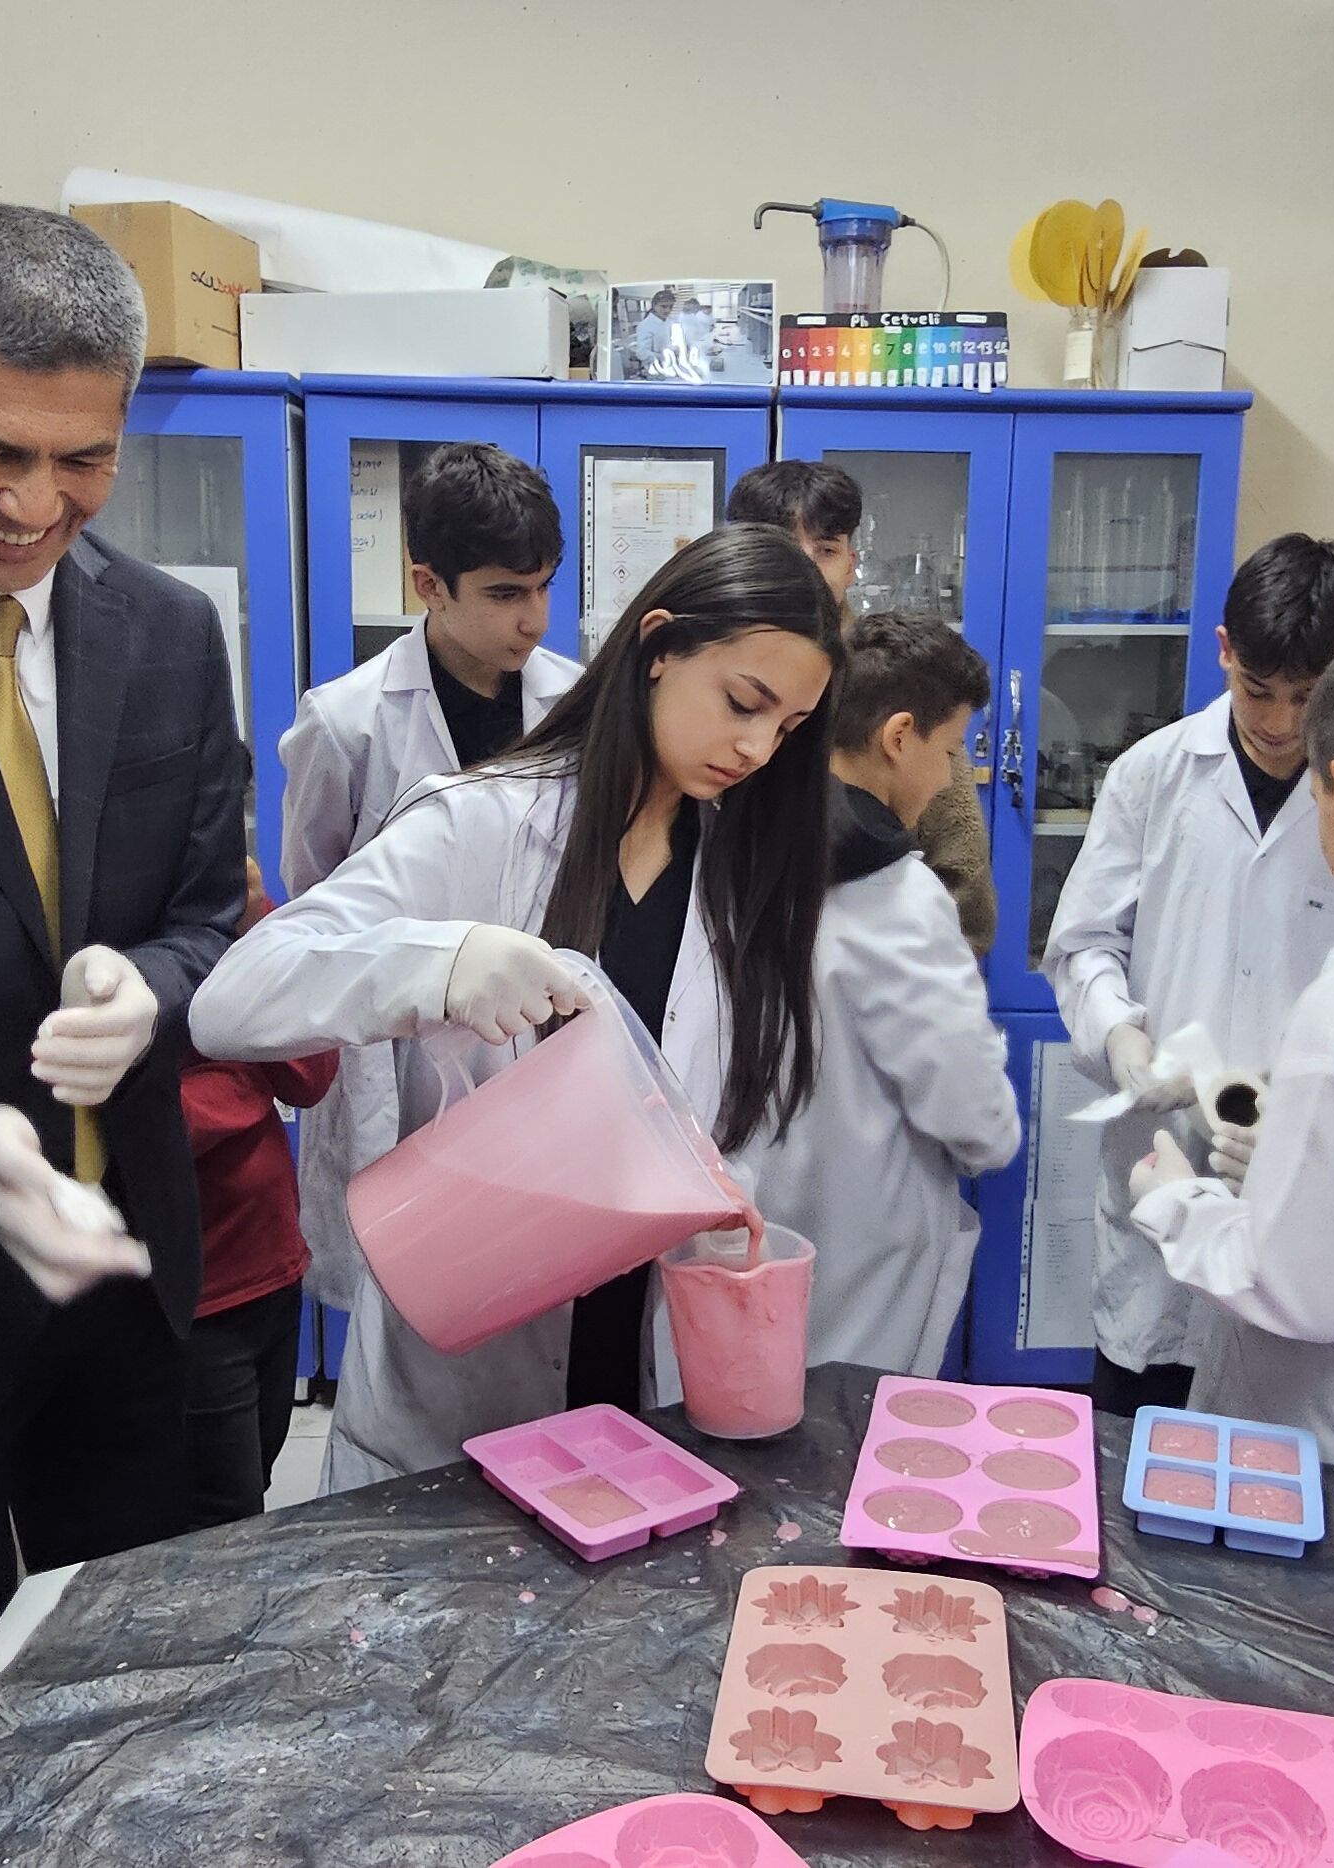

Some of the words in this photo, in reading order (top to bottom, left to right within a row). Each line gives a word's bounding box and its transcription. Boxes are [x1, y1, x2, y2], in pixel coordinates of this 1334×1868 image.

[850, 314, 869, 328] Ph
[782, 348, 792, 359] 0
[798, 346, 806, 358] 1
[811, 345, 822, 357] 2
[825, 345, 835, 357] 3
[841, 344, 851, 358] 4
[859, 343, 868, 356] 5
[873, 343, 882, 356] 6
[886, 344, 895, 356] 7
[902, 342, 913, 355] 8
[932, 342, 947, 354] 10
[949, 341, 962, 354] 11
[963, 341, 977, 354] 12
[977, 341, 994, 356] 13
